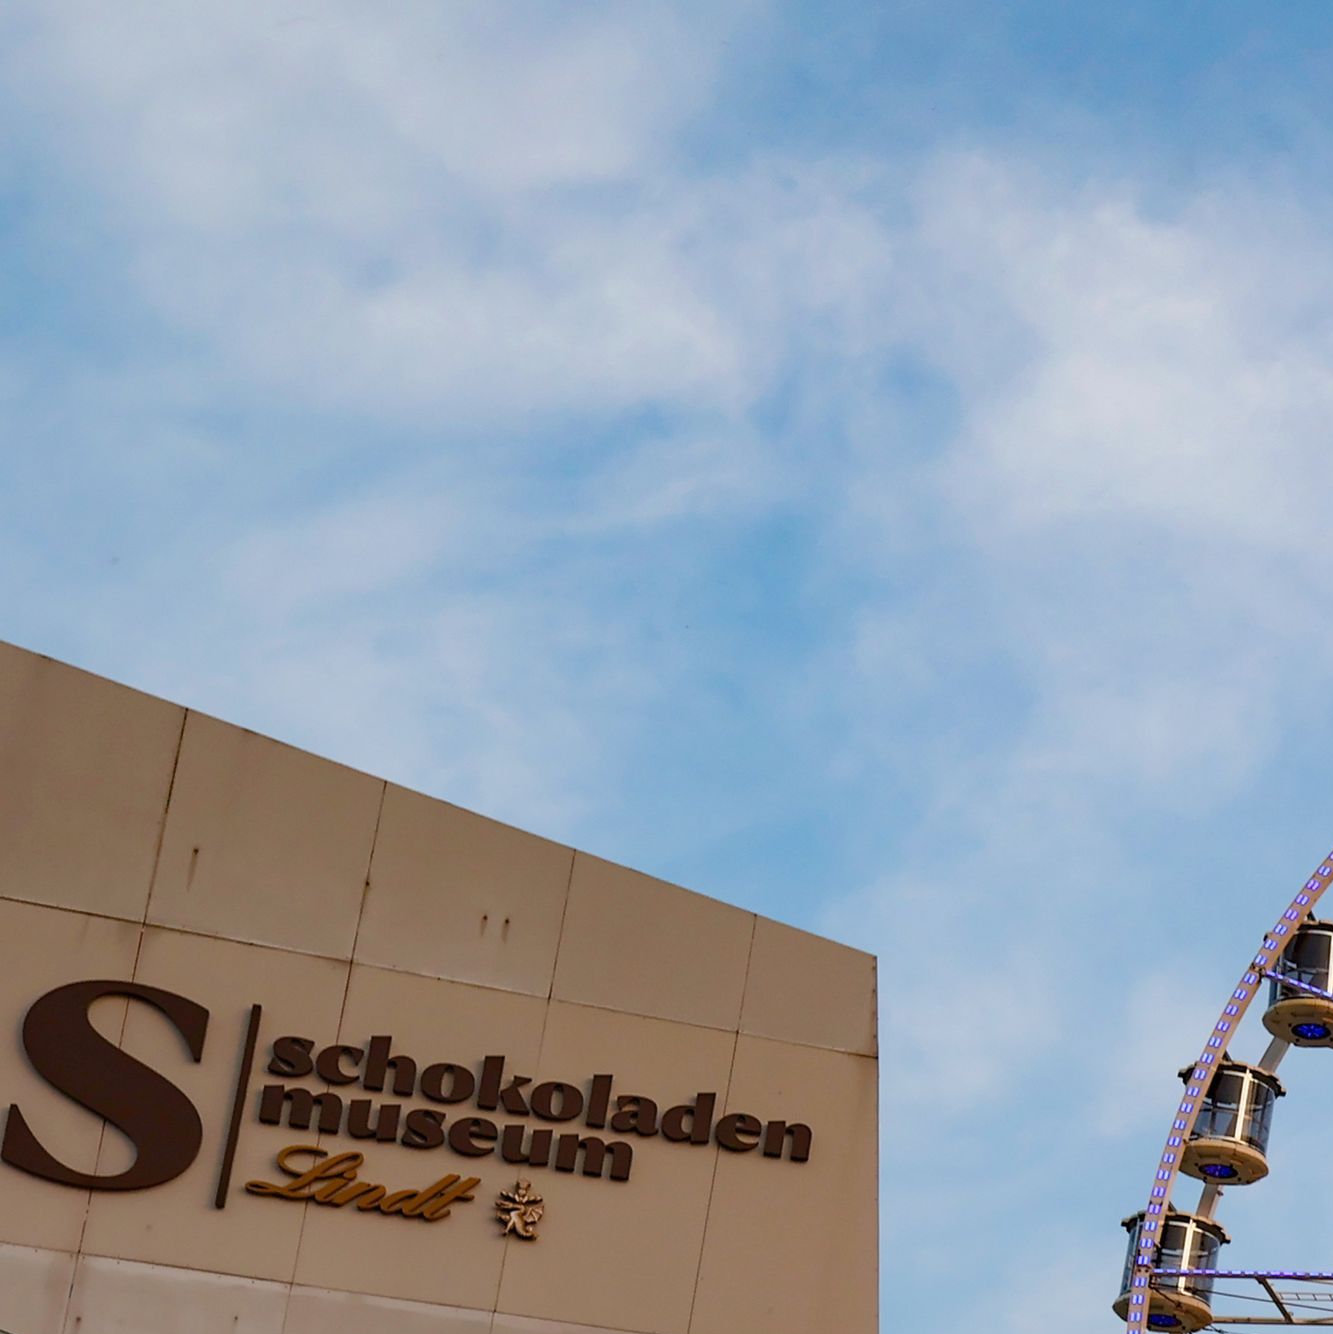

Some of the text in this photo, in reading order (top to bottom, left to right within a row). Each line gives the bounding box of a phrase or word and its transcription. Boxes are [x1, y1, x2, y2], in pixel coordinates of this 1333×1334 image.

[1, 979, 210, 1191] S
[259, 1083, 635, 1181] museum
[267, 1034, 812, 1162] schokoladen
[245, 1144, 481, 1222] Lindt
